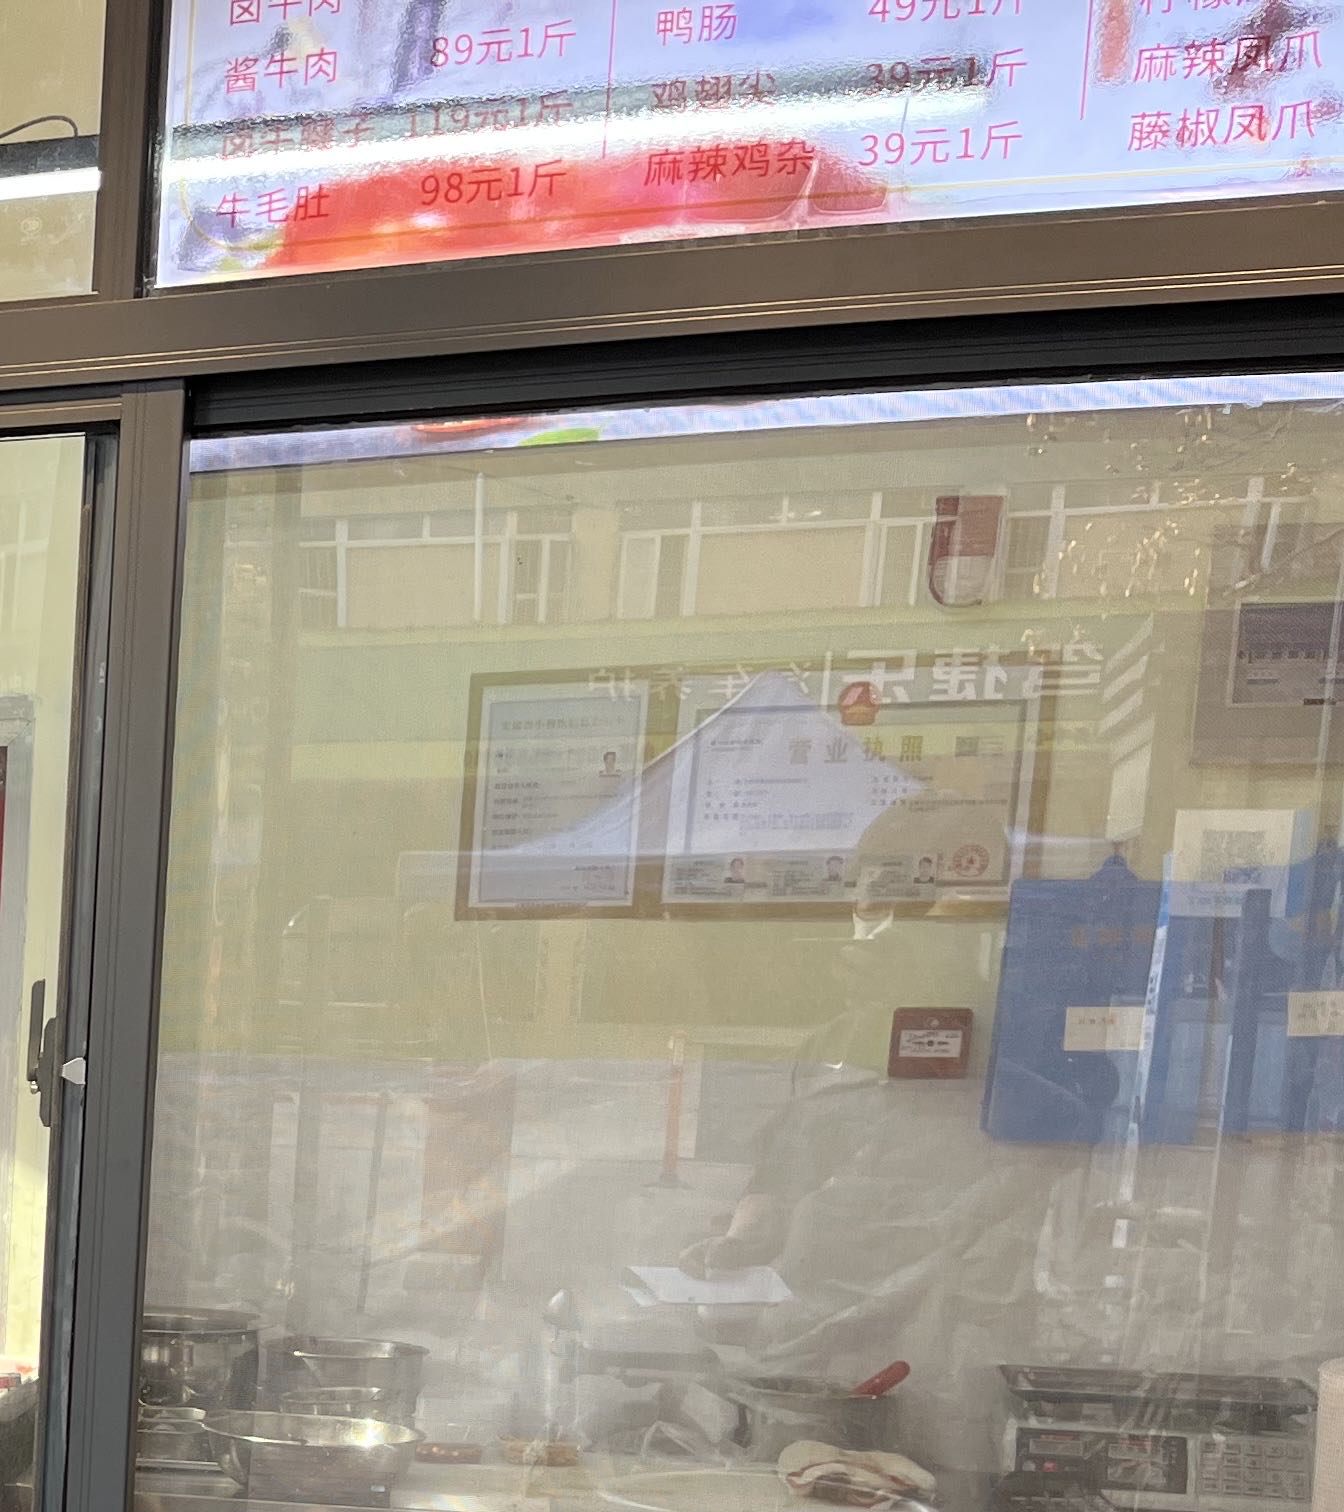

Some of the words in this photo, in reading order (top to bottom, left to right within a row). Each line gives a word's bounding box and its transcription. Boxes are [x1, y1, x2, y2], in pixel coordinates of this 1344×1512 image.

[430, 19, 576, 68] 89元1斤
[656, 3, 737, 46] 鸭肠
[224, 48, 338, 94] 酱牛肉
[866, 48, 1028, 97] 39元1斤
[1133, 31, 1323, 83] 麻辣凤爪
[858, 121, 1024, 168] 39元1斤
[1128, 100, 1316, 152] 藤椒凤爪
[420, 159, 568, 206] 98元1斤
[644, 140, 816, 187] 麻辣鸡杂
[215, 184, 330, 228] 牛毛肚
